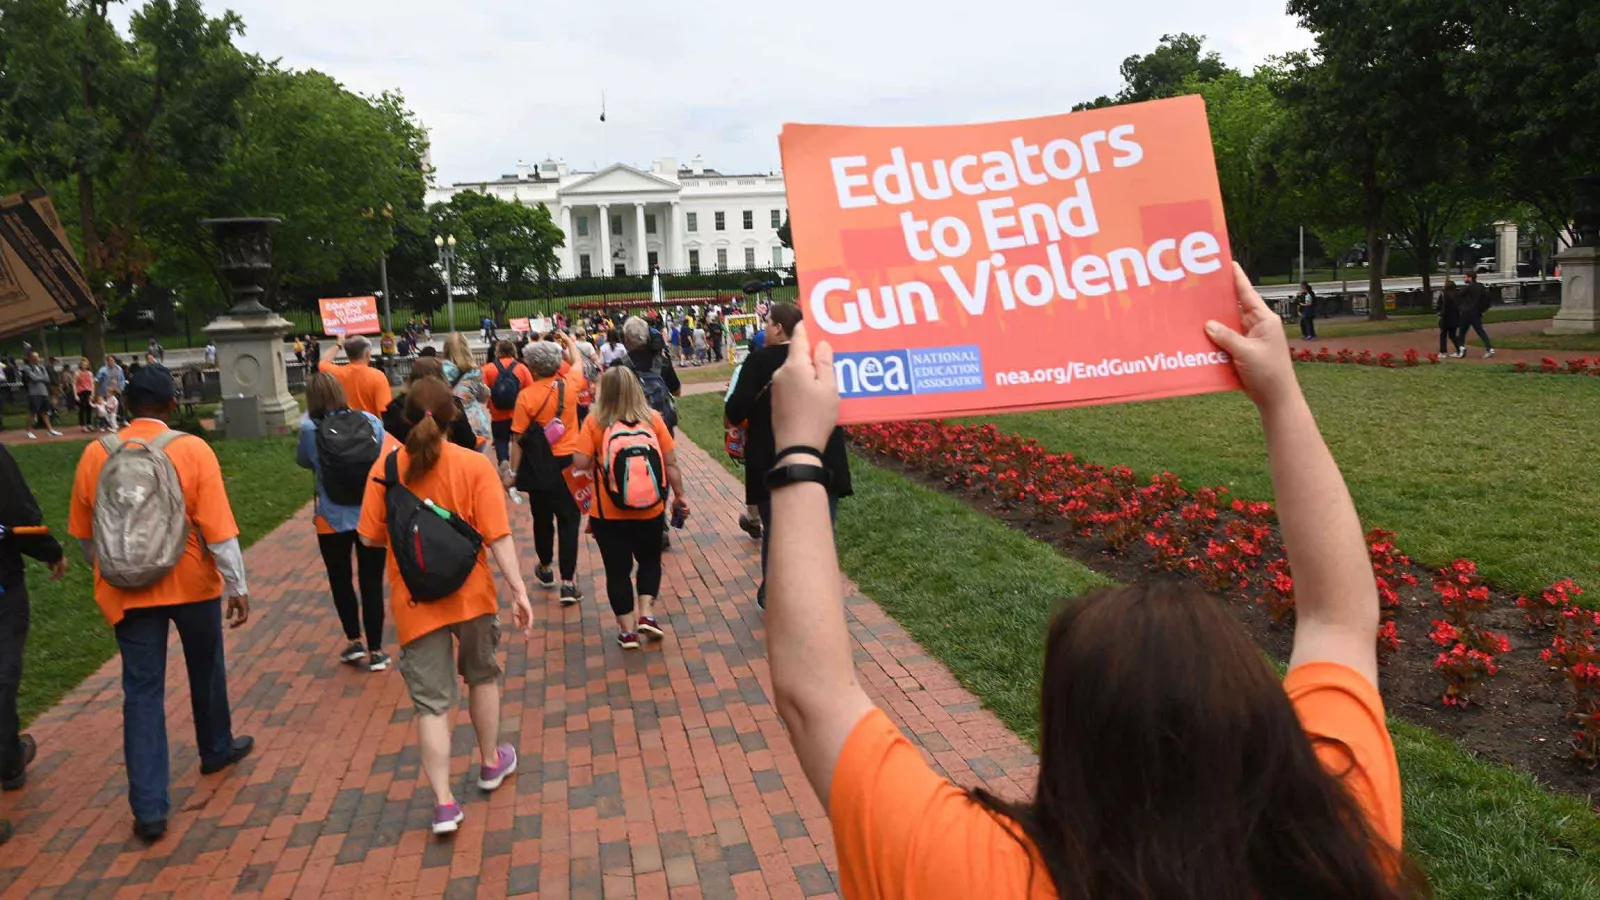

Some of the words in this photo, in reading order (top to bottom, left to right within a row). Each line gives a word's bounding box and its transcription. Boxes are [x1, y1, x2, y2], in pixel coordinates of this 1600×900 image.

[829, 124, 1143, 209] Educators
[900, 210, 972, 262] to
[977, 177, 1099, 251] End
[810, 277, 939, 334] Gun
[938, 232, 1221, 315] Violence
[834, 355, 909, 393] nea
[912, 351, 978, 365] NATIONAL
[914, 362, 981, 377] EDUCATION
[995, 350, 1230, 386] nea.org/EndGunViolence
[916, 376, 983, 389] ASSOCIATION
